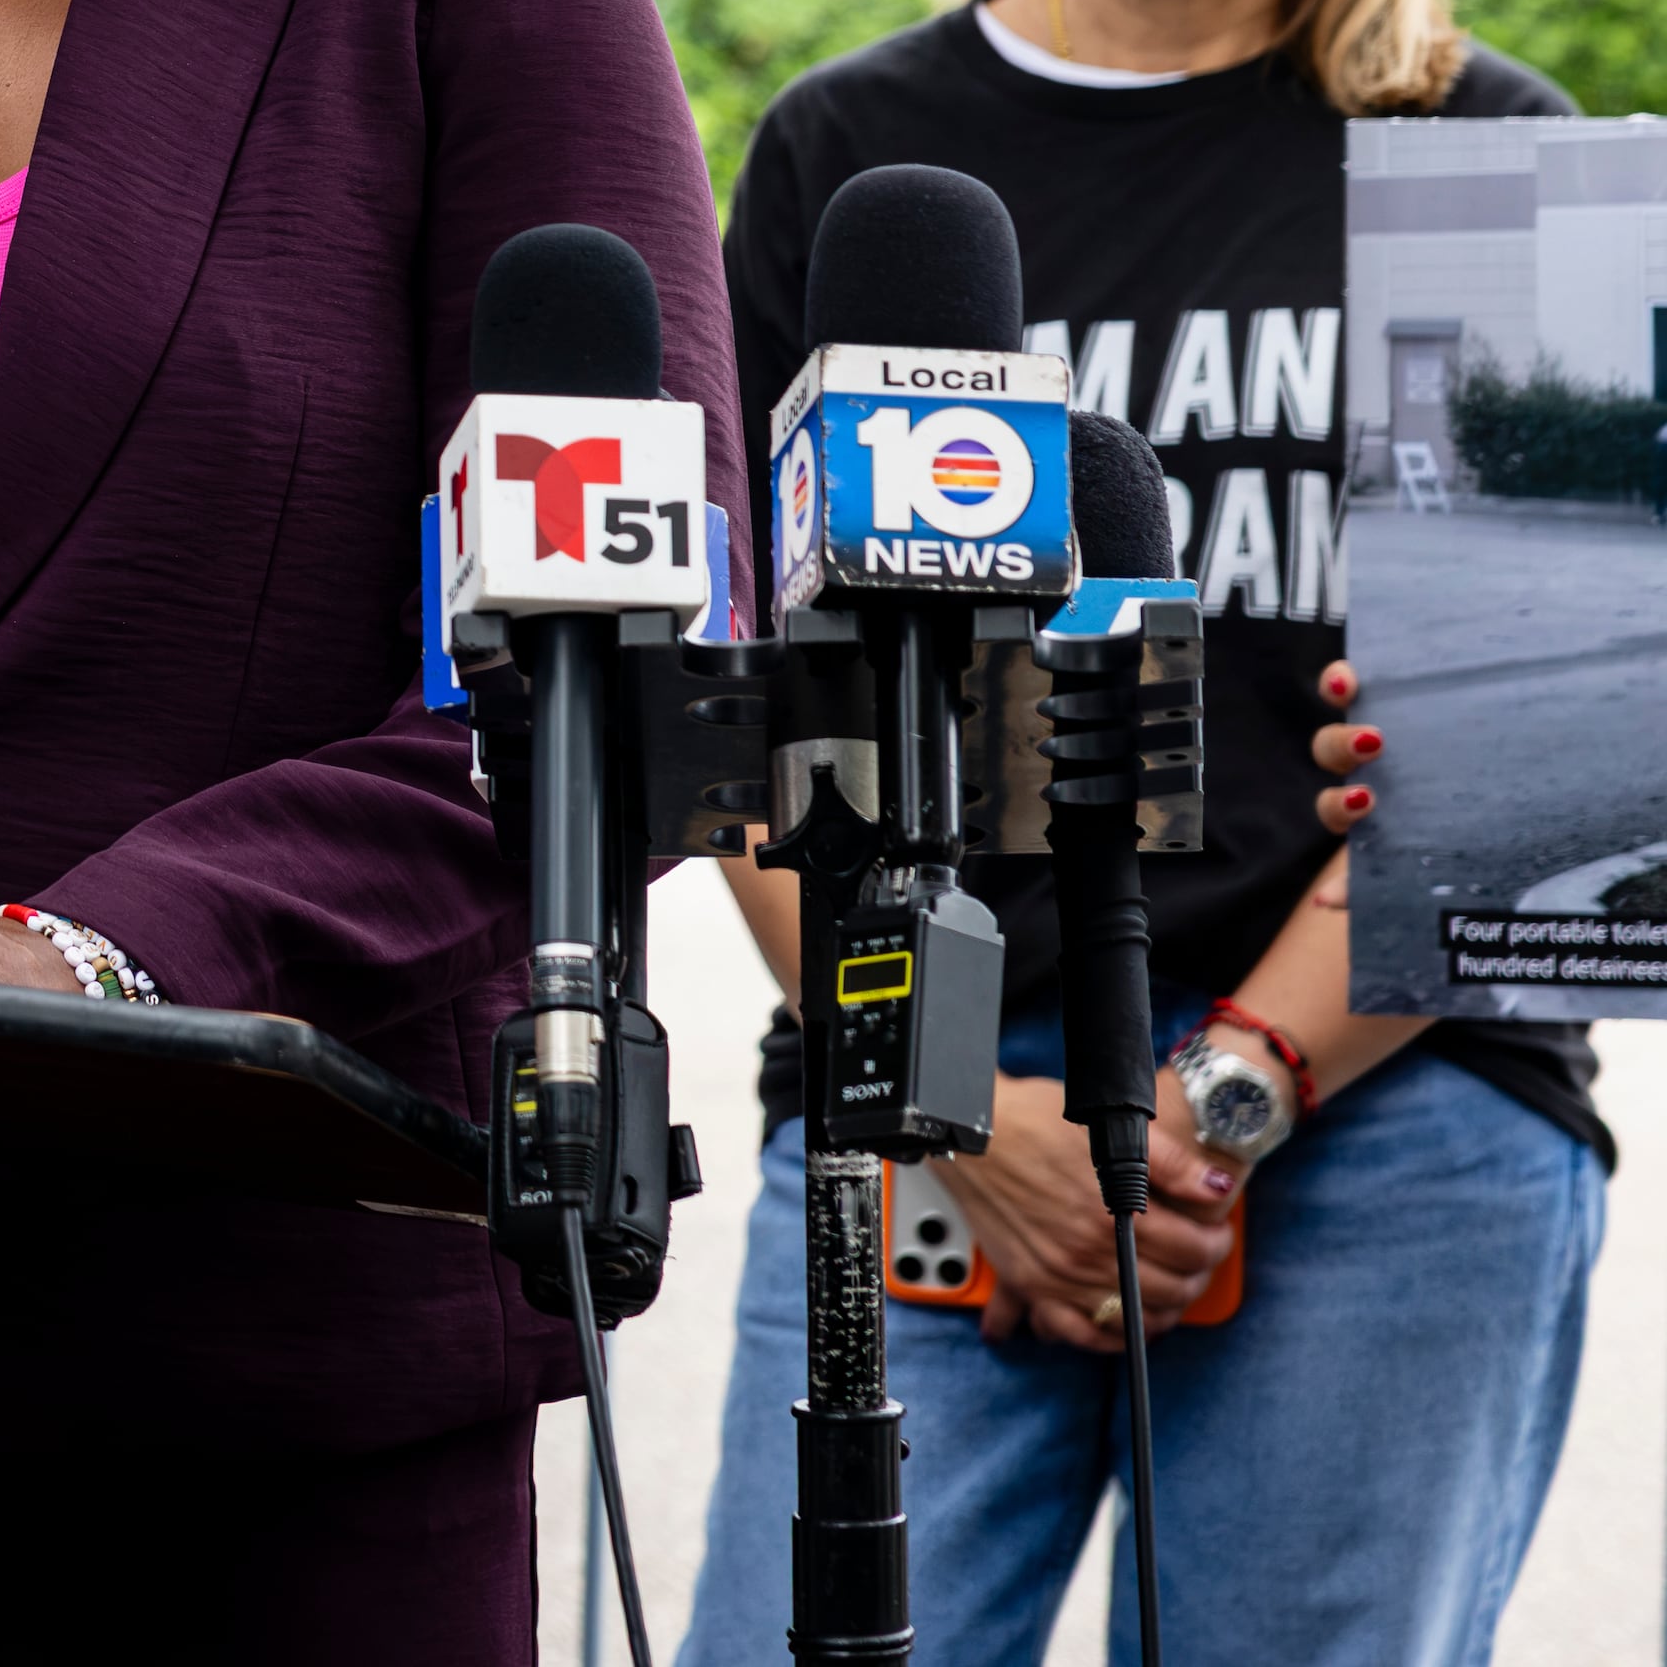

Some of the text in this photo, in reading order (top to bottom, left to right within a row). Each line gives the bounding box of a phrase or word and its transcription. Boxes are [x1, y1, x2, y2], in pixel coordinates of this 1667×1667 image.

[882, 361, 1008, 392] Local
[857, 406, 1034, 539] 10
[778, 427, 816, 581] 10
[600, 497, 691, 568] 51
[781, 549, 817, 613] NEWS
[865, 537, 1035, 581] NEWS
[1450, 916, 1506, 941] Four
[1508, 919, 1609, 948] portable
[1458, 953, 1556, 978] hundred
[841, 1079, 894, 1103] SONY
